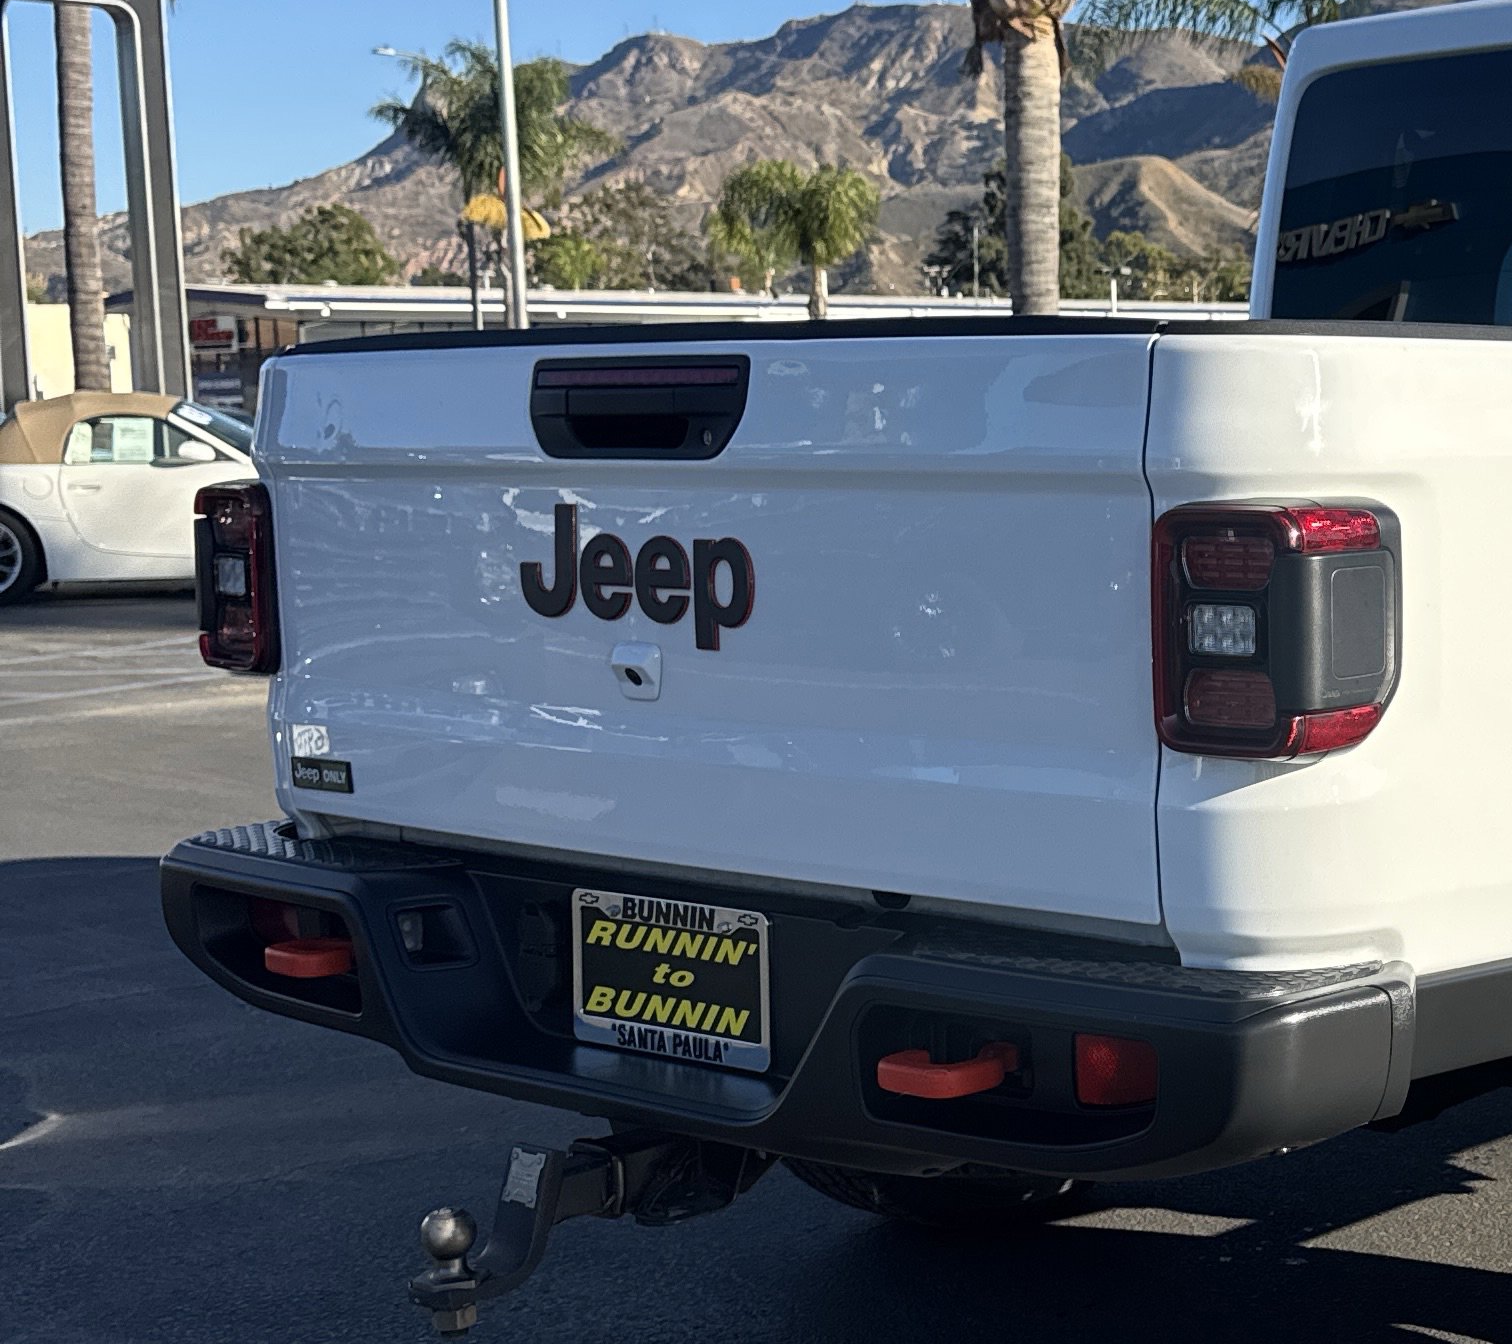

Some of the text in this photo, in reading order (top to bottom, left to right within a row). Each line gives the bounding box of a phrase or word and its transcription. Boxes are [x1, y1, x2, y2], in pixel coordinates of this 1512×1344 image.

[519, 503, 756, 651] Jeep
[294, 761, 347, 785] Jeep ONLY
[621, 896, 716, 932] BUNNIN
[585, 919, 758, 966] RUNNIN'
[652, 962, 695, 987] to
[585, 985, 750, 1037] BUNNIN
